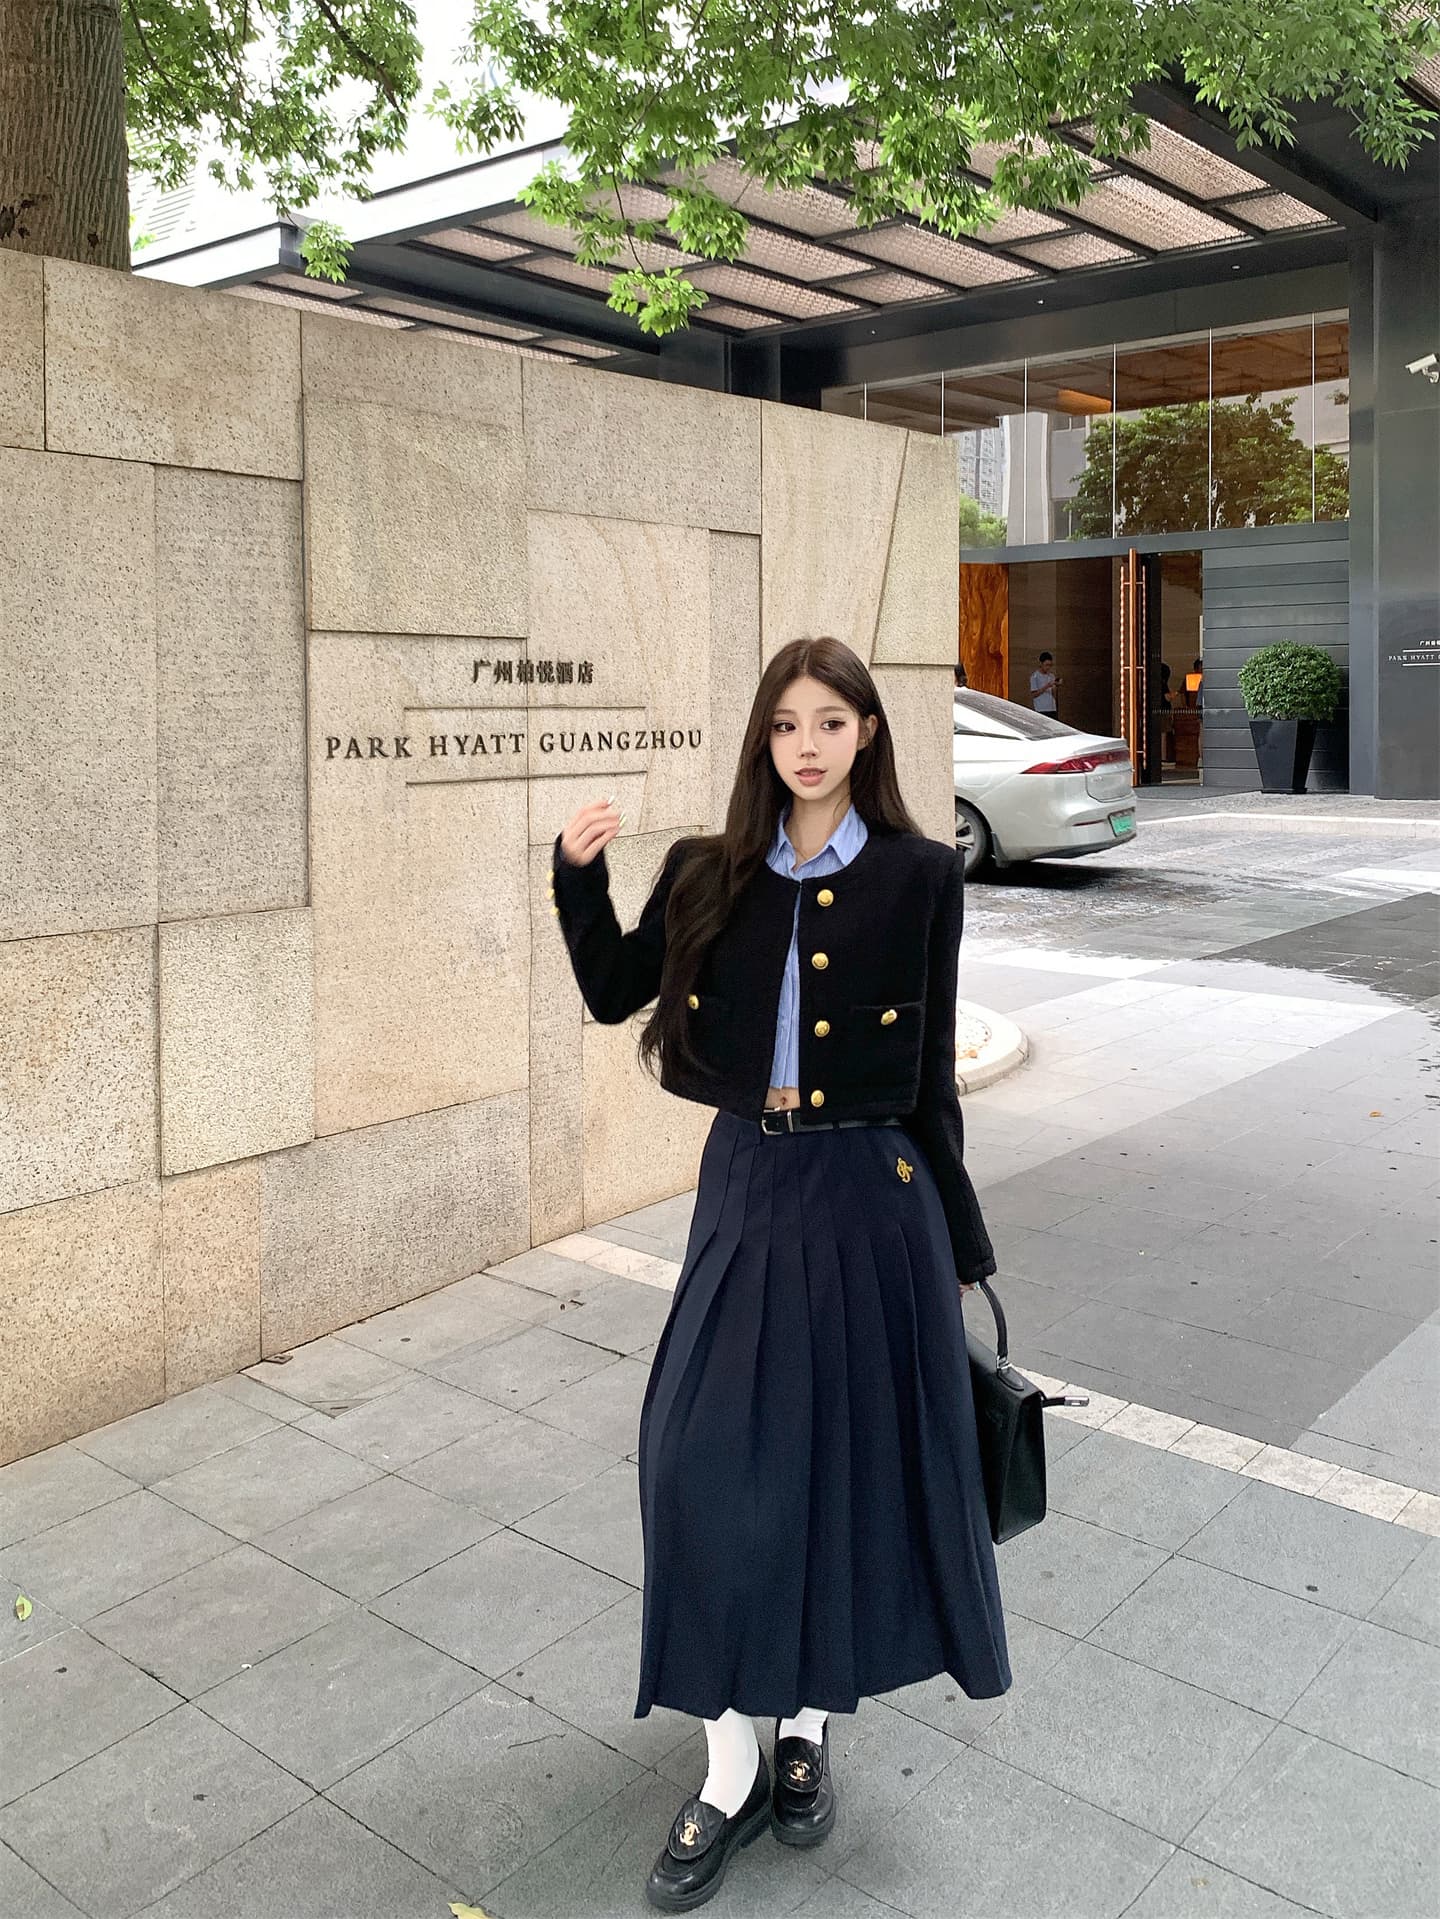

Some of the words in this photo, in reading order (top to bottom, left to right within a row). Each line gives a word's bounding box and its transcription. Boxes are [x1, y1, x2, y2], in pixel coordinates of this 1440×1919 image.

[472, 659, 594, 685] 广州柏悦酒店
[325, 736, 413, 760] PARK
[429, 733, 526, 757] HYATT
[539, 729, 703, 753] GUANGZHOU
